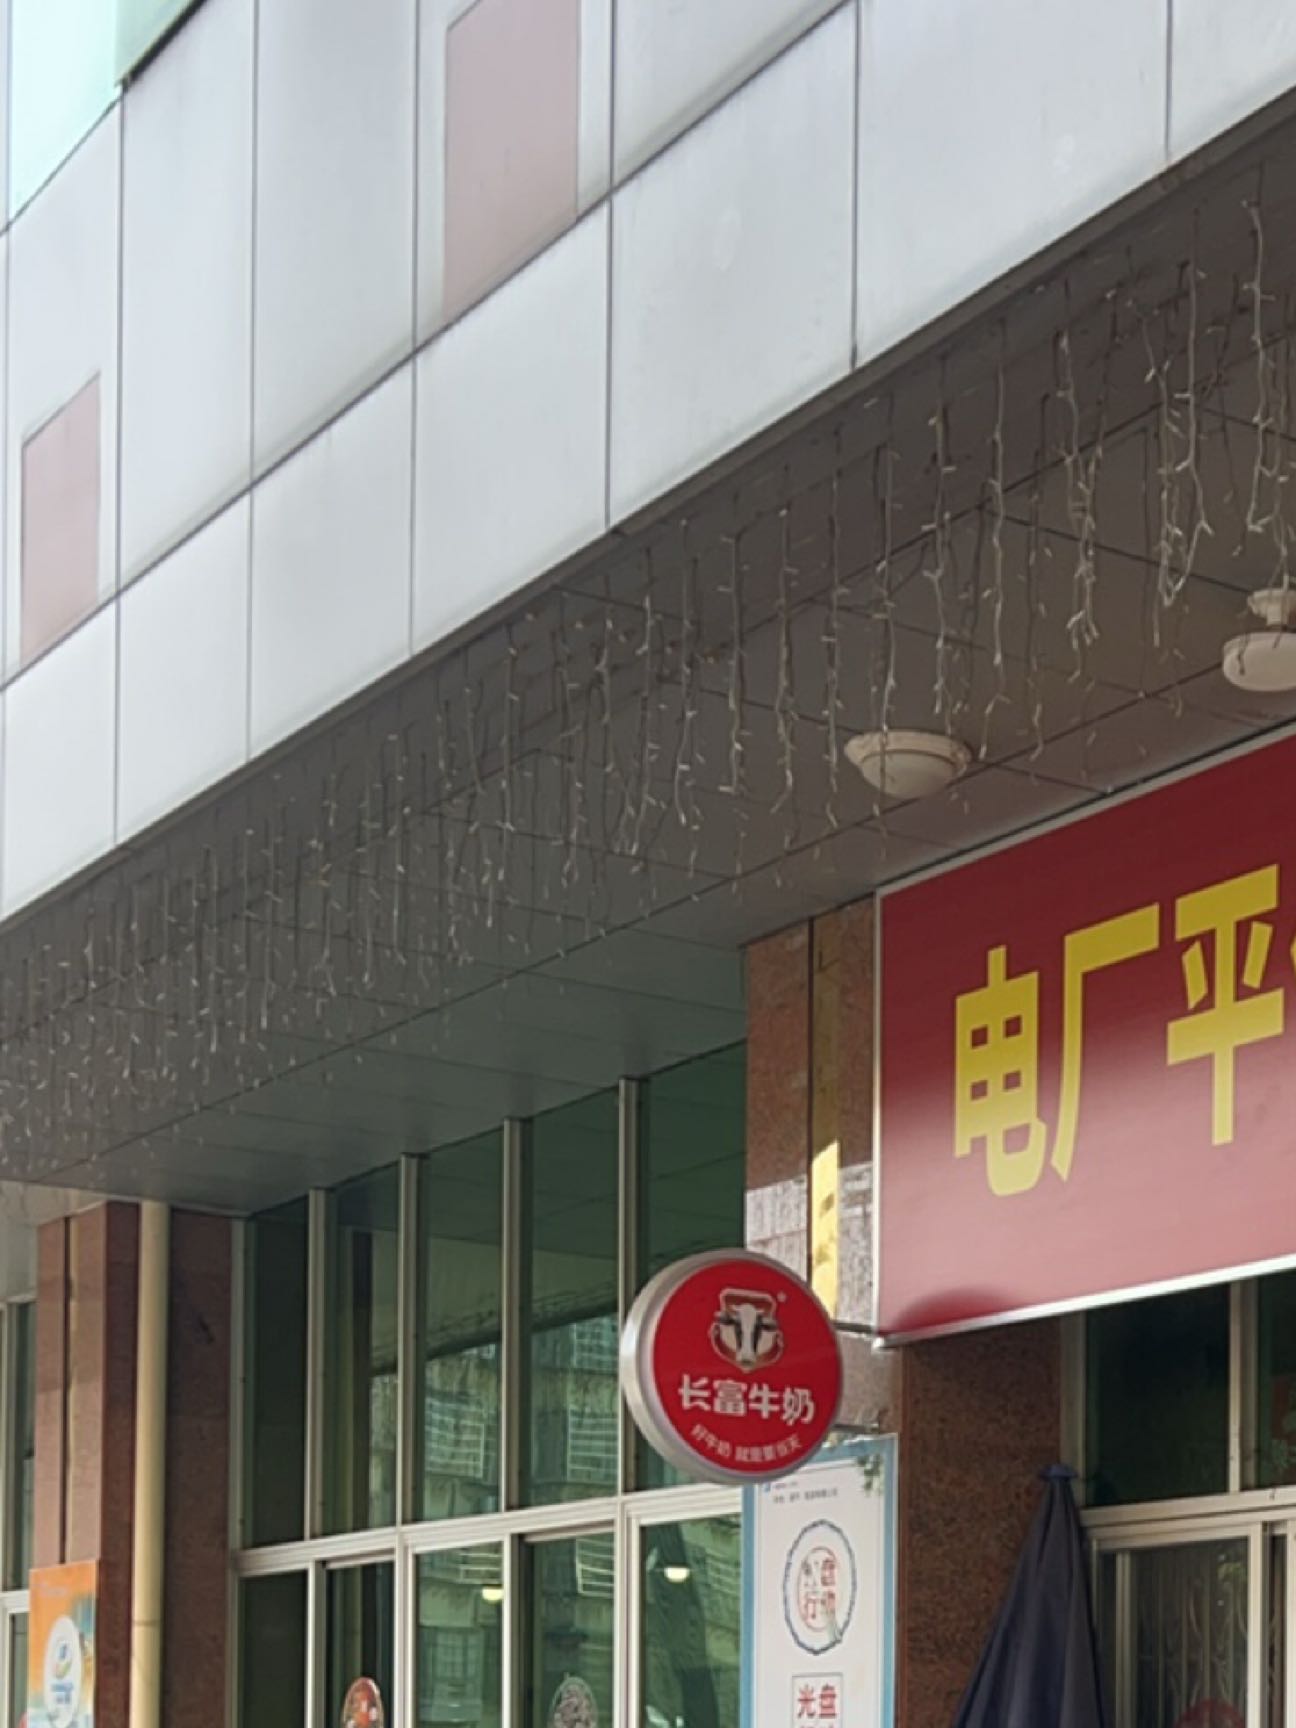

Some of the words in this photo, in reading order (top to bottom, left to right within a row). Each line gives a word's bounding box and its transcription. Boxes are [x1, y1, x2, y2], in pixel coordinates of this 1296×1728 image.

[677, 1373, 816, 1426] 长富牛奶
[796, 1683, 838, 1720] 光盘
